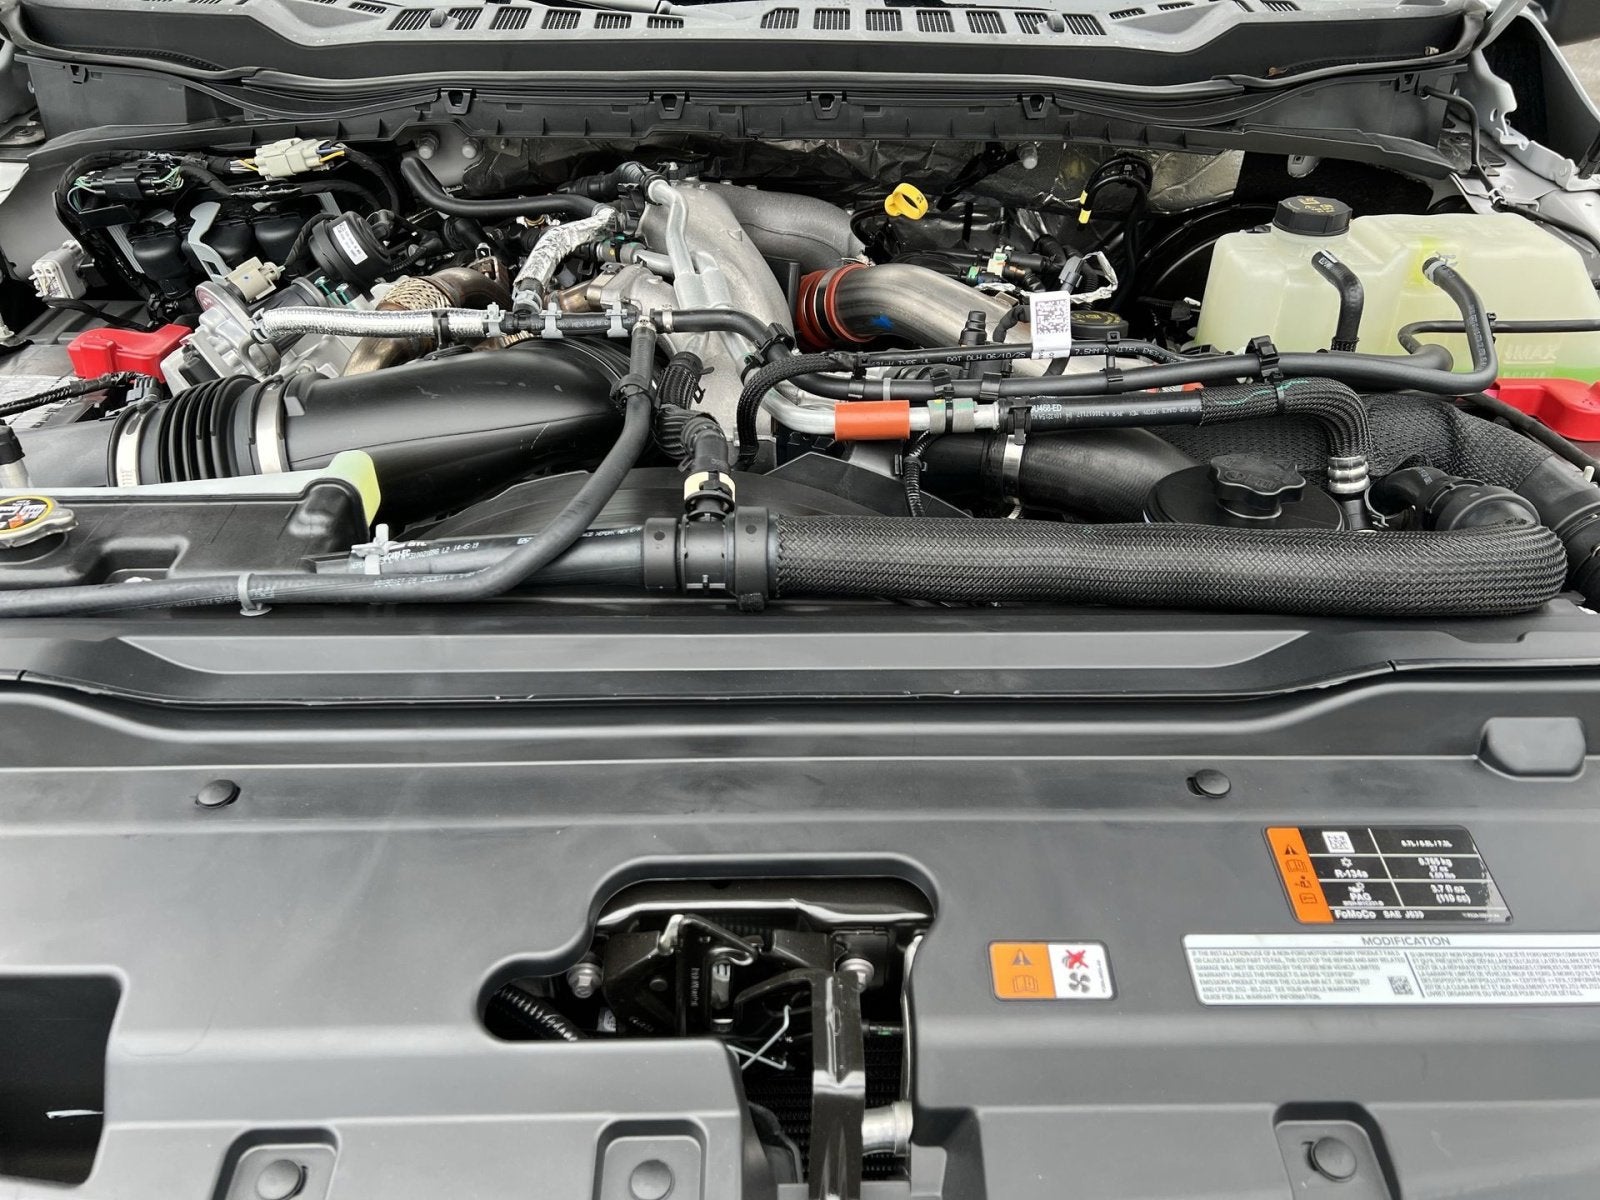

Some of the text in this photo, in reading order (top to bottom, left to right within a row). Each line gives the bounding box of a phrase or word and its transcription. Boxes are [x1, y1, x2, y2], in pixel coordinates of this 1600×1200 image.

[1334, 869, 1369, 879] R-134a
[1349, 892, 1372, 901] PAG
[1334, 909, 1377, 919] FoMoCo
[1382, 910, 1402, 919] SAE
[1362, 937, 1451, 946] MODIFICATION
